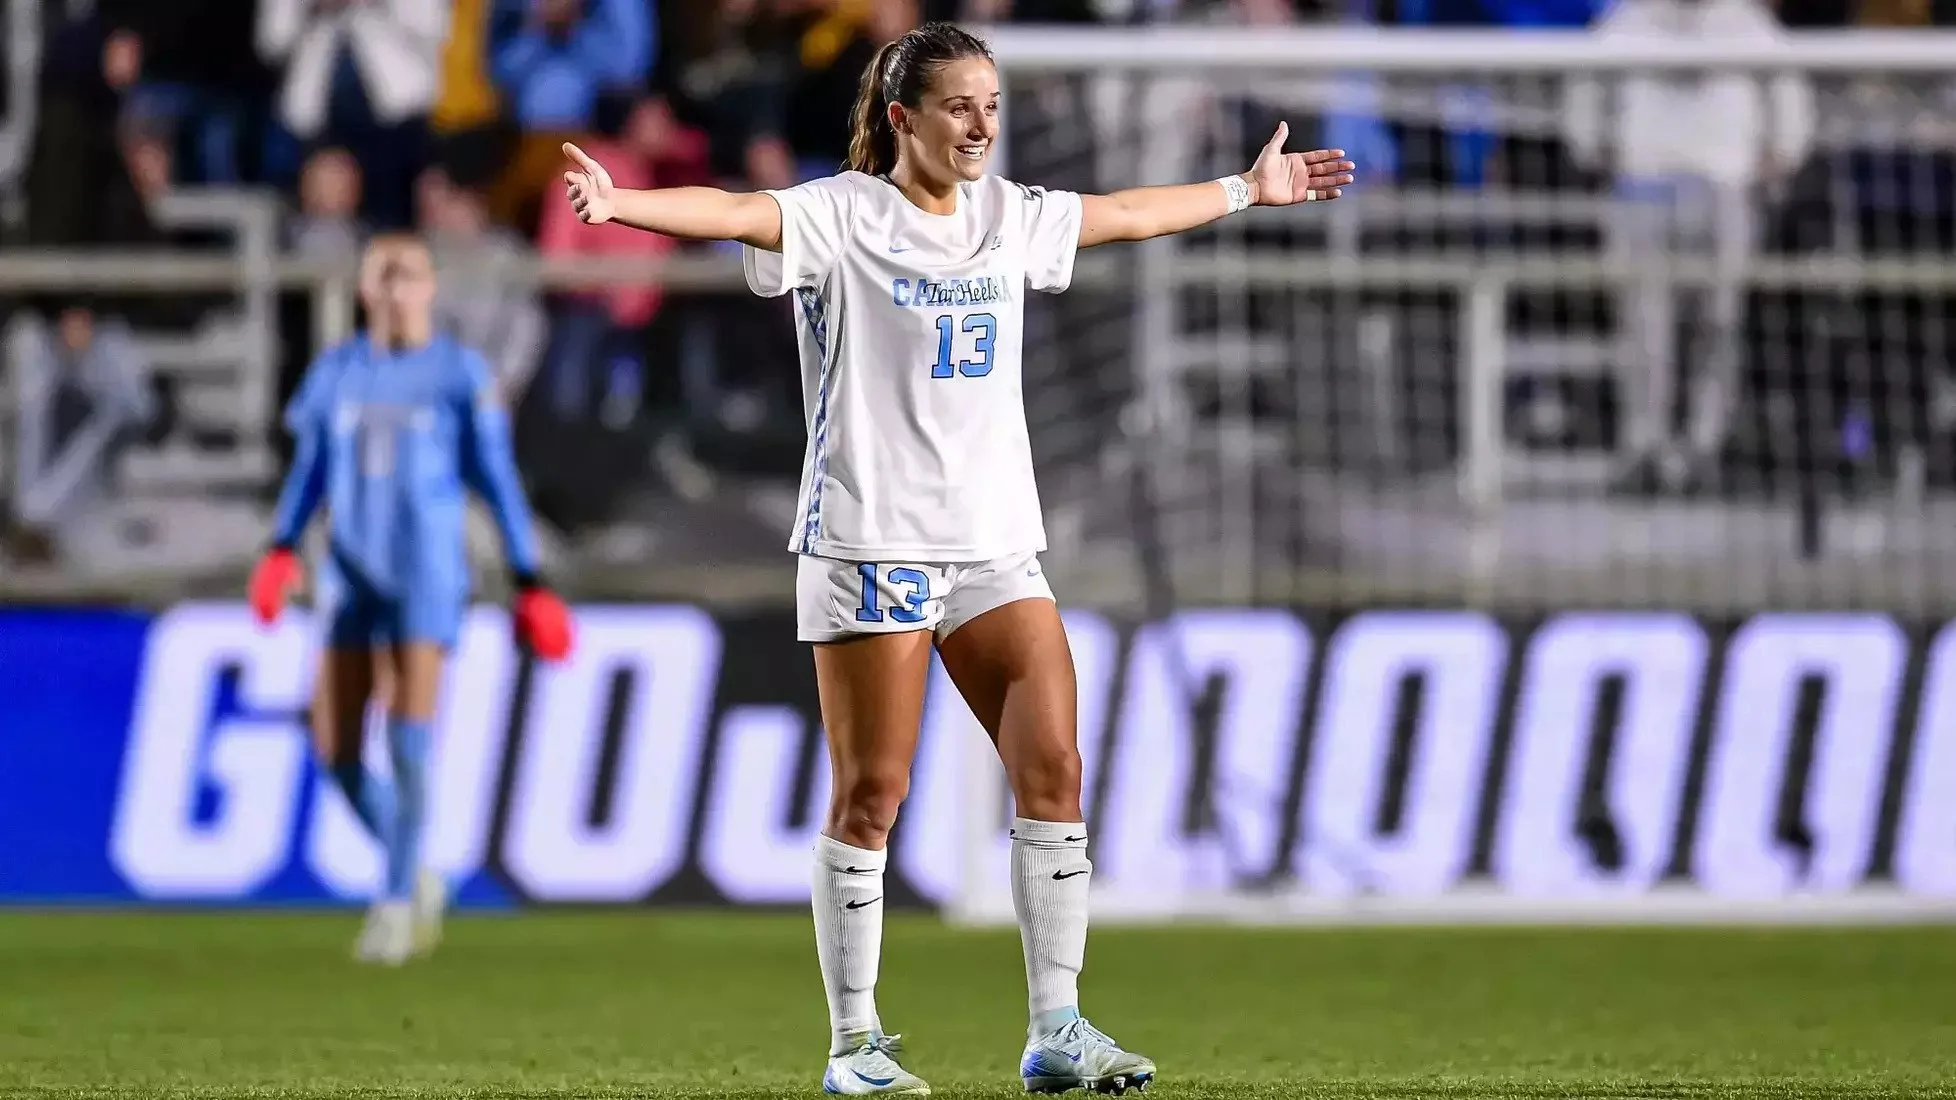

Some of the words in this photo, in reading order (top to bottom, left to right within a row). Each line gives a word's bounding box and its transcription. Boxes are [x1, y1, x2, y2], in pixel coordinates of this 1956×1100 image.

[923, 282, 954, 303] Tar
[957, 278, 999, 302] Heels
[931, 312, 997, 378] 13
[856, 562, 931, 623] 13
